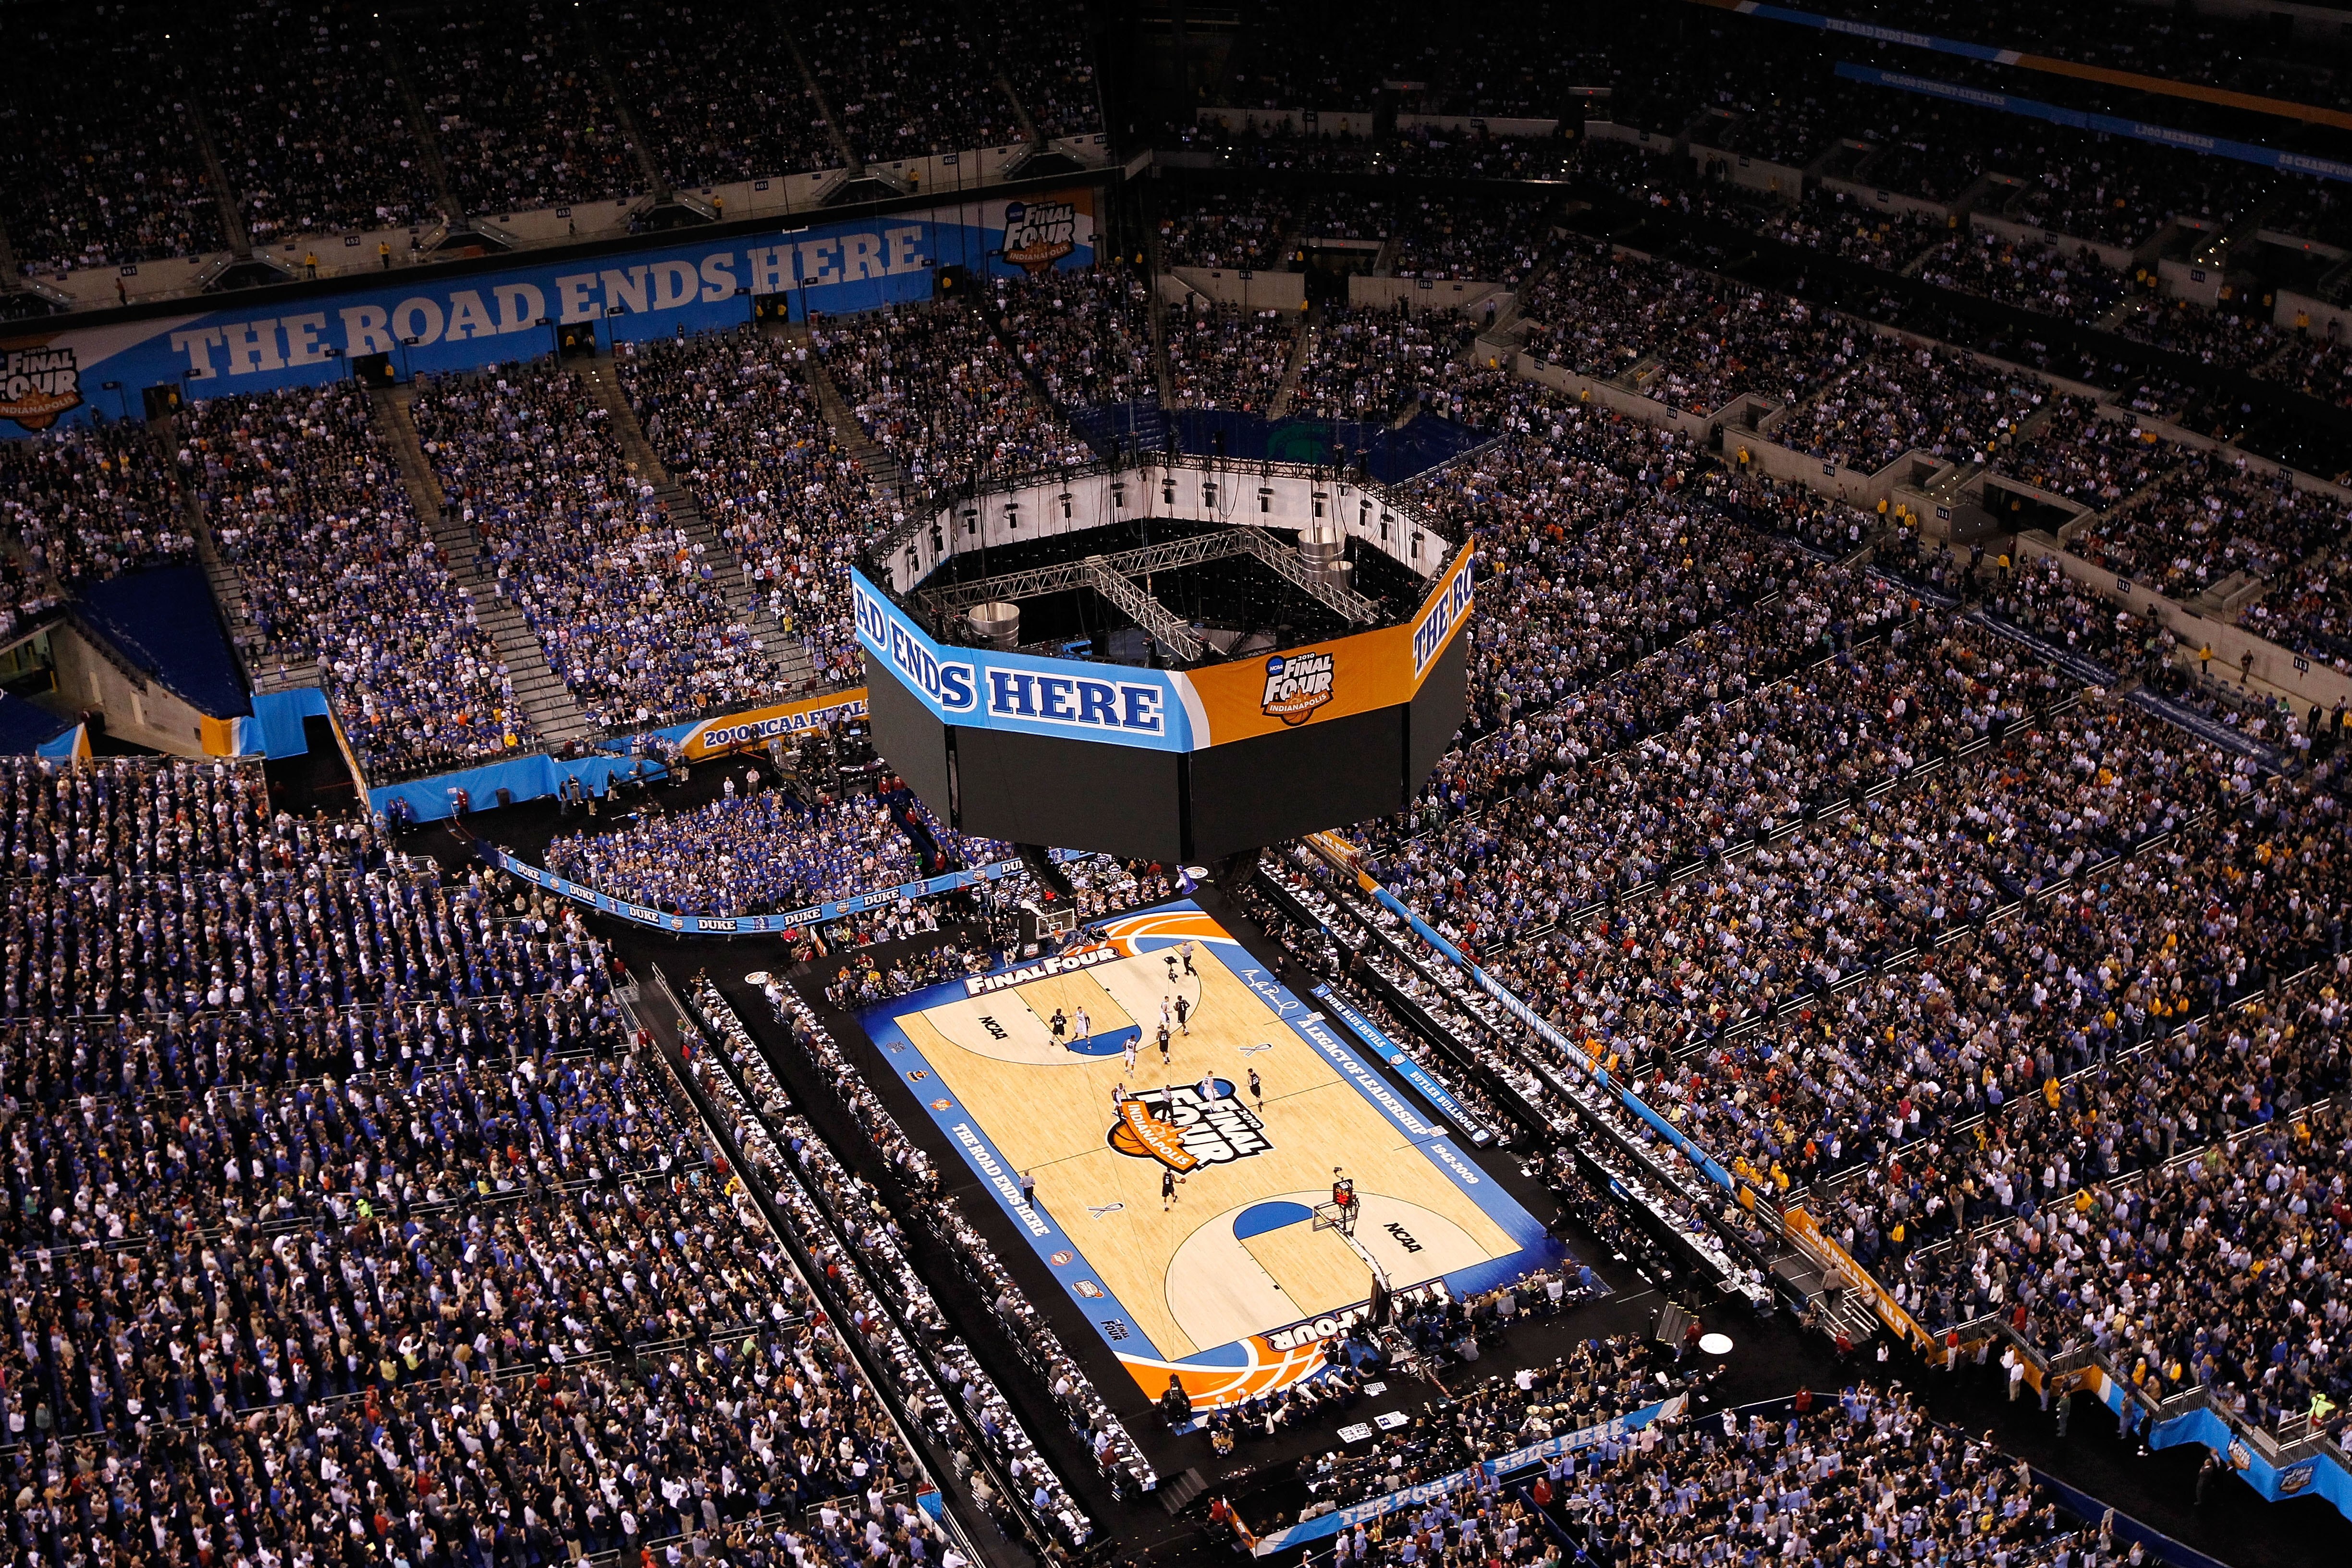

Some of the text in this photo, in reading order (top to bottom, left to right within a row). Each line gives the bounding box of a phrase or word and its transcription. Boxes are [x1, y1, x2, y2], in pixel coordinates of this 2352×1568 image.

[944, 156, 956, 164] 402
[756, 182, 767, 190] 401
[557, 208, 570, 217] 453
[1023, 206, 1073, 227] FINAL
[1003, 222, 1073, 252] FOUR
[171, 225, 924, 381] THE ROAD ENDS HERE
[8, 351, 73, 376] FINAL
[1824, 464, 1834, 475] 110
[1937, 508, 1948, 519] 111
[2118, 579, 2129, 592] 112
[1414, 589, 1450, 676] THE
[890, 620, 1163, 734] ENDS HERE
[1269, 664, 1284, 672] NCAA
[1283, 656, 1332, 680] FINAL
[1263, 672, 1332, 705] FOUR
[1269, 693, 1327, 712] INDIANAPOLIS
[705, 726, 751, 747] 2010
[755, 714, 808, 735] NCAA
[517, 865, 540, 881] DUKE
[569, 885, 596, 903] DUKE
[864, 889, 900, 907] DUKE
[629, 906, 660, 923] DUKE
[698, 919, 736, 930] DUKE
[784, 908, 821, 926] DUKE
[966, 948, 1118, 995] FINAL FOUR
[1502, 990, 1536, 1026] ROAD
[979, 1016, 1008, 1040] NCAA
[1323, 993, 1345, 1014] DUKE
[1344, 1012, 1363, 1031] BLUE
[1358, 1025, 1386, 1049] DEVILS
[1298, 1020, 1308, 1029] A
[1305, 1026, 1352, 1062] LEGACY
[1343, 1060, 1365, 1077] OF
[1355, 1071, 1428, 1136] LEADERSHIP
[1409, 1070, 1478, 1133] BUTLER BULLDOGS
[1136, 1088, 1235, 1166] FOUR
[1195, 1098, 1266, 1154] FINAL
[1237, 1109, 1261, 1129] 2010
[1127, 1103, 1190, 1165] INDIANAPOLIS
[1431, 1143, 1480, 1184] 1942-2009
[952, 1122, 1051, 1237] THE ROAD ENDS HERE
[1383, 1223, 1423, 1253] NCAA
[1805, 1223, 1830, 1253] 2010
[1099, 1320, 1123, 1342] FOUR
[1115, 1323, 1130, 1339] FINAL
[1365, 1383, 1386, 1393] NOISE
[1354, 1424, 1370, 1436] HEY
[1378, 1417, 1391, 1427] B
[1339, 1496, 1393, 1526] THE
[1494, 1439, 1557, 1474] ENDS
[1559, 1417, 1624, 1452] HERE
